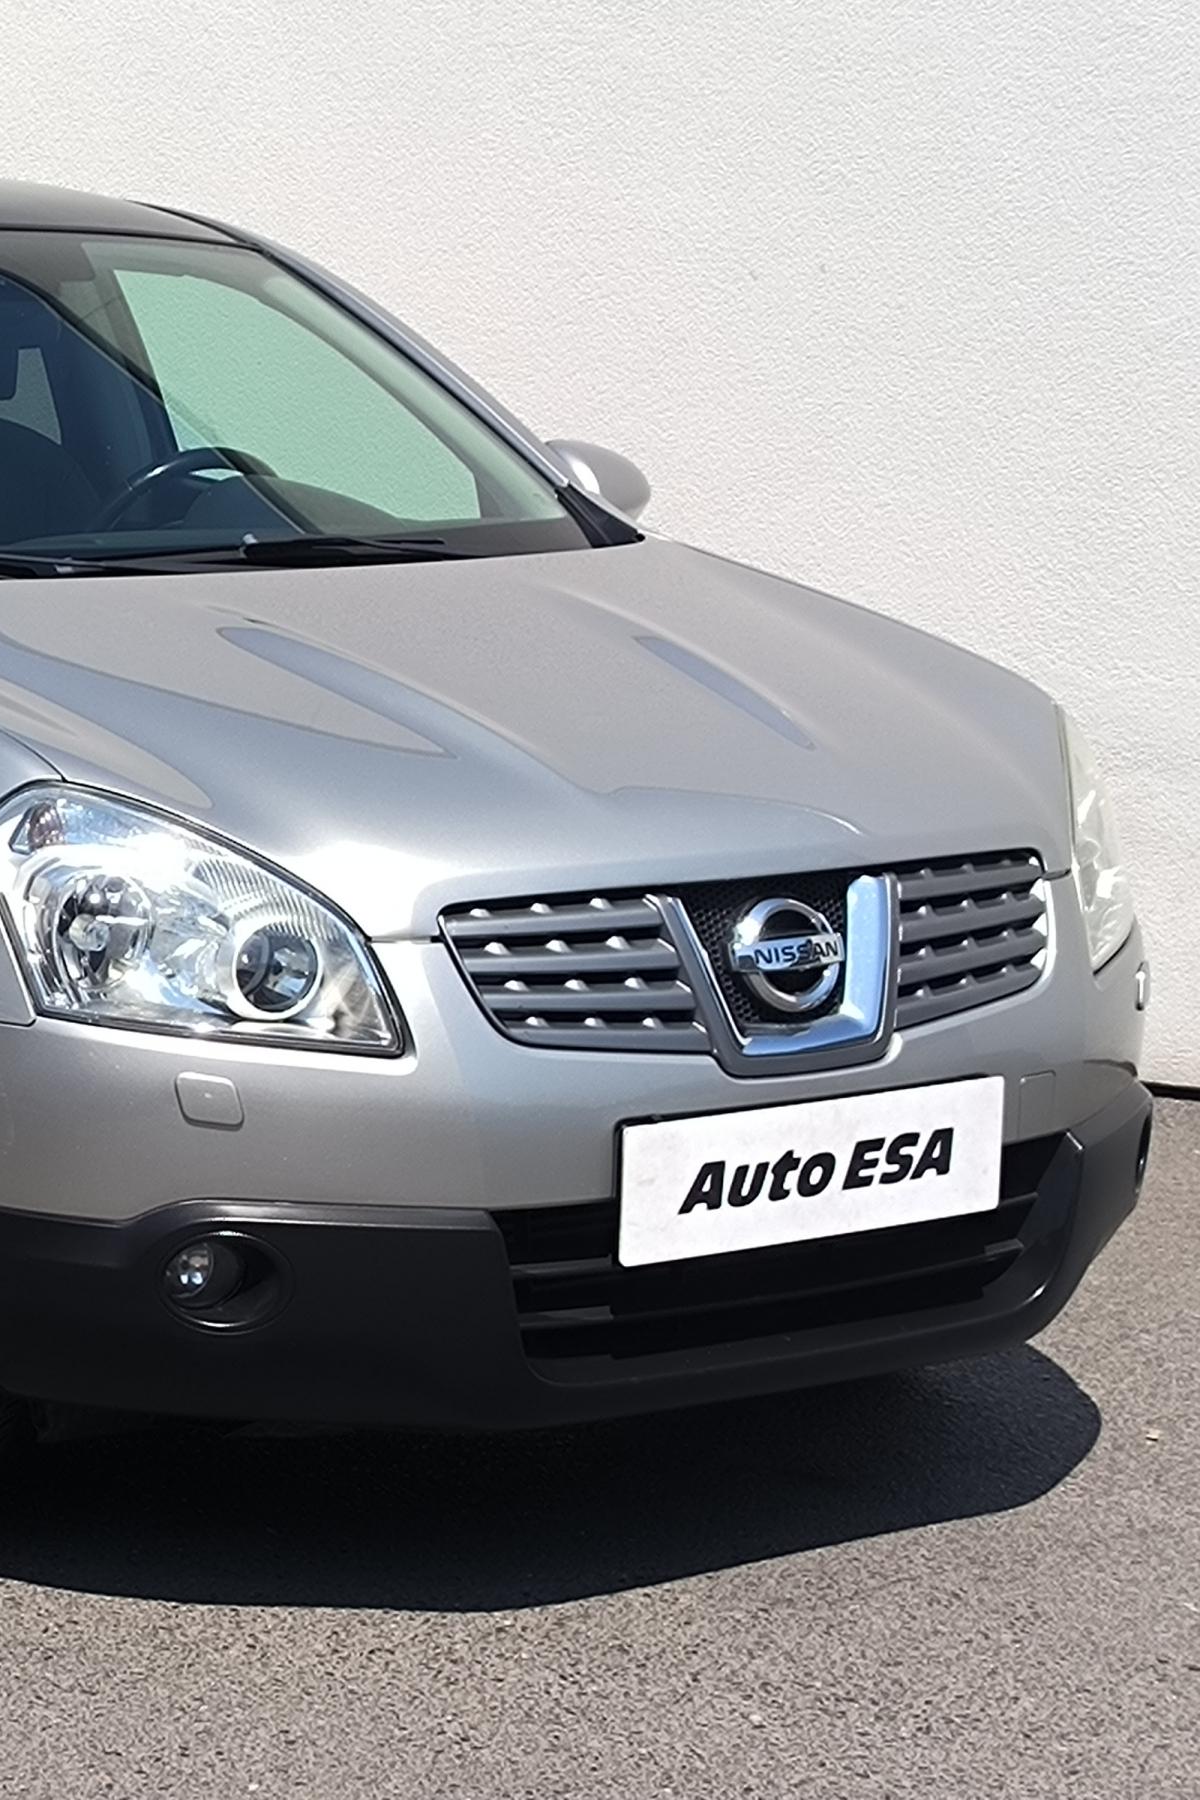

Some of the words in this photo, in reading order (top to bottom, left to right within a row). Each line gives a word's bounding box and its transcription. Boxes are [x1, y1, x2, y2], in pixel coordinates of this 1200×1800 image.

[753, 940, 839, 964] NISSAN
[677, 1149, 836, 1215] Auto
[842, 1127, 954, 1190] ESA
